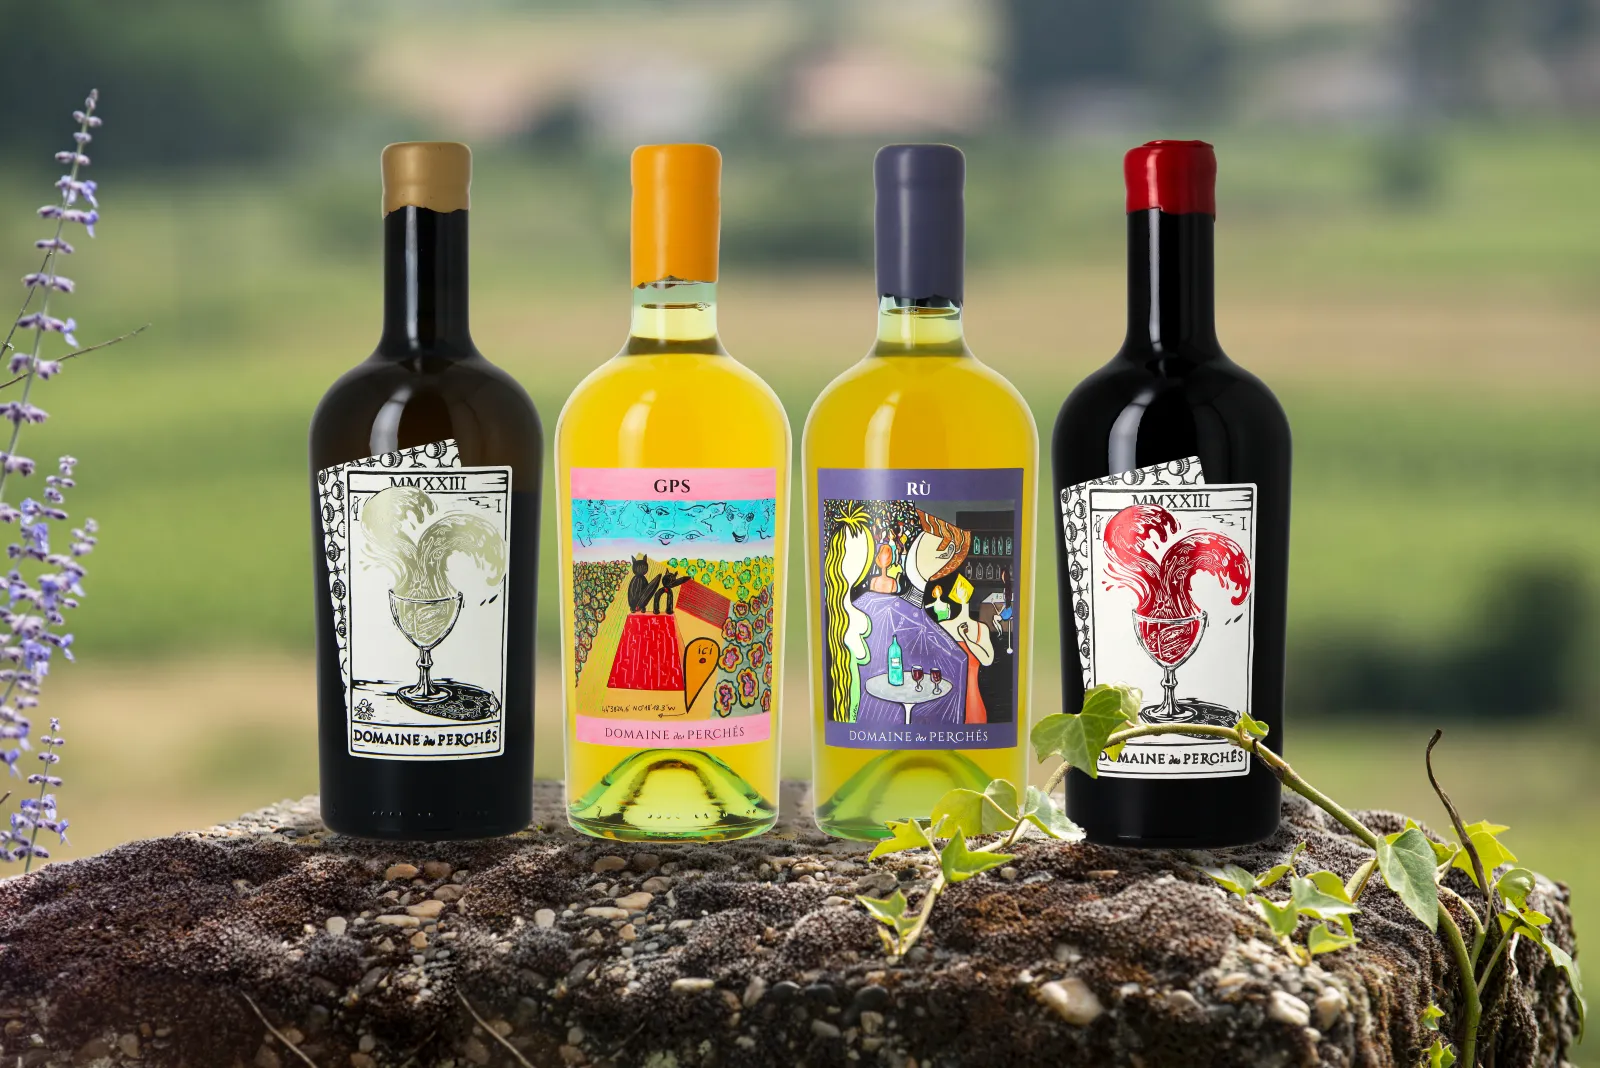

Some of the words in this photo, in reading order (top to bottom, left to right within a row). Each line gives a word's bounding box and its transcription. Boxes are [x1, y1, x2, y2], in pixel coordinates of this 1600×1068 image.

[389, 476, 467, 490] MMXXIII
[654, 479, 691, 493] GPS
[906, 479, 931, 496] RÙ
[1131, 493, 1211, 508] MMXXIII
[698, 643, 714, 655] ici
[353, 729, 420, 746] DOMAINE
[423, 735, 436, 746] des
[438, 728, 498, 747] PERCHÉS
[605, 727, 670, 740] DOMAINE
[673, 732, 685, 740] des
[687, 725, 745, 740] PERCHÉS
[849, 730, 912, 741] DOMAINE
[915, 733, 927, 742] des
[929, 729, 988, 743] PERCHÉS
[1168, 754, 1181, 765] des
[1183, 749, 1244, 766] PERCHÉS
